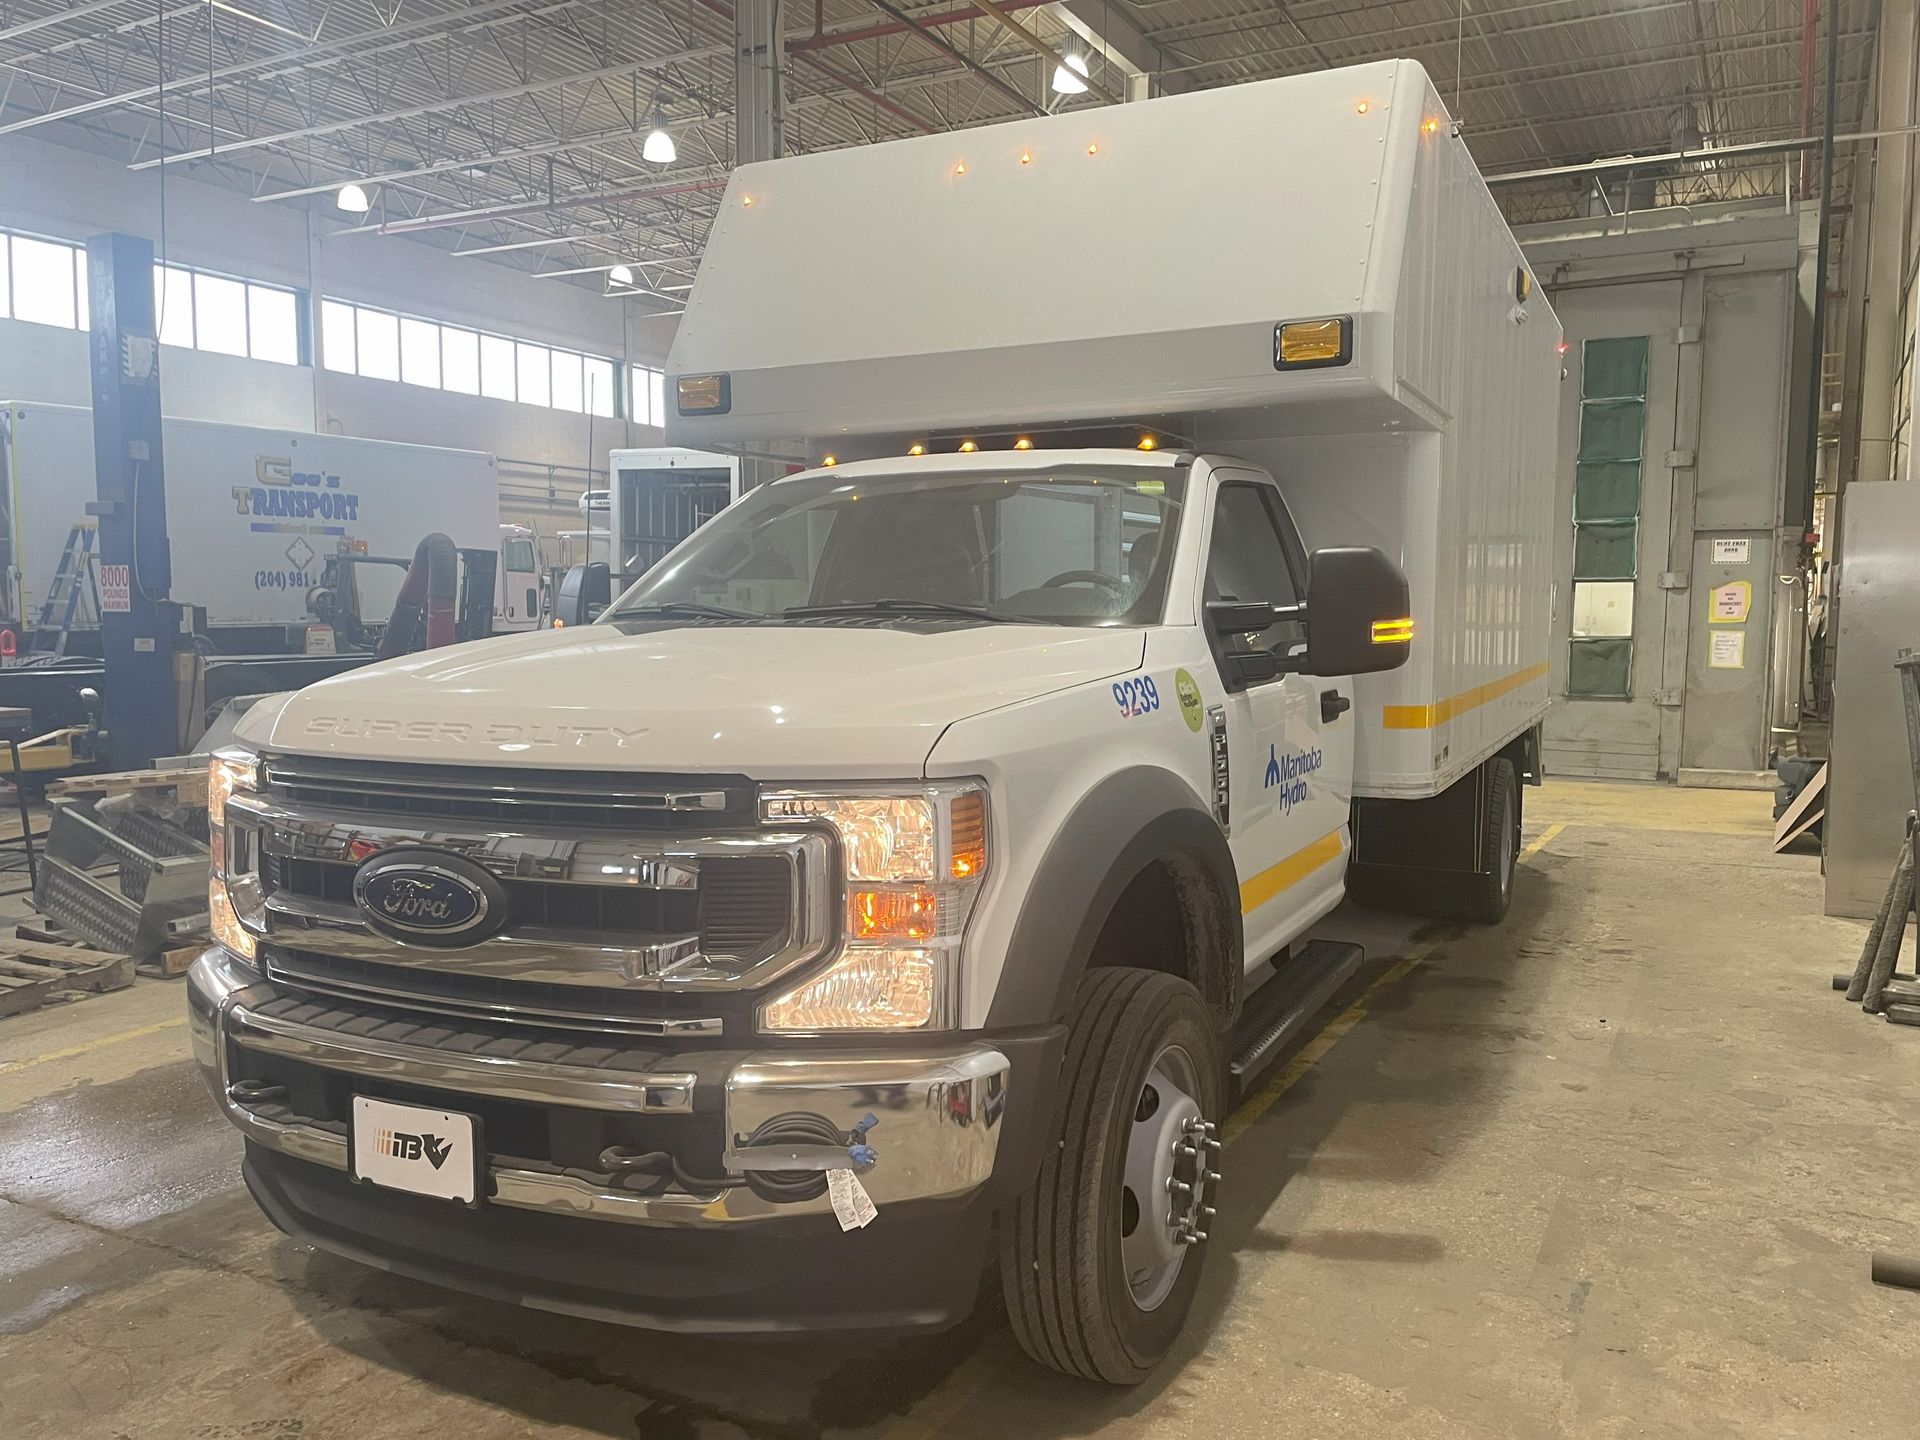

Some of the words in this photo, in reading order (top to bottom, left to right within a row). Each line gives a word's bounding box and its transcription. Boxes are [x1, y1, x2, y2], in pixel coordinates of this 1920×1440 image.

[232, 486, 359, 520] TRANSPORT
[101, 567, 128, 587] 8000
[254, 571, 286, 591] (204)
[103, 589, 128, 599] POUNDS
[104, 601, 128, 610] MAXIMUM
[1112, 675, 1160, 719] 9239
[304, 716, 473, 744] SUPER
[480, 723, 650, 748] DUTY
[1280, 745, 1322, 783] Manitoba
[1279, 778, 1307, 816] Hydro
[384, 878, 452, 919] Ford
